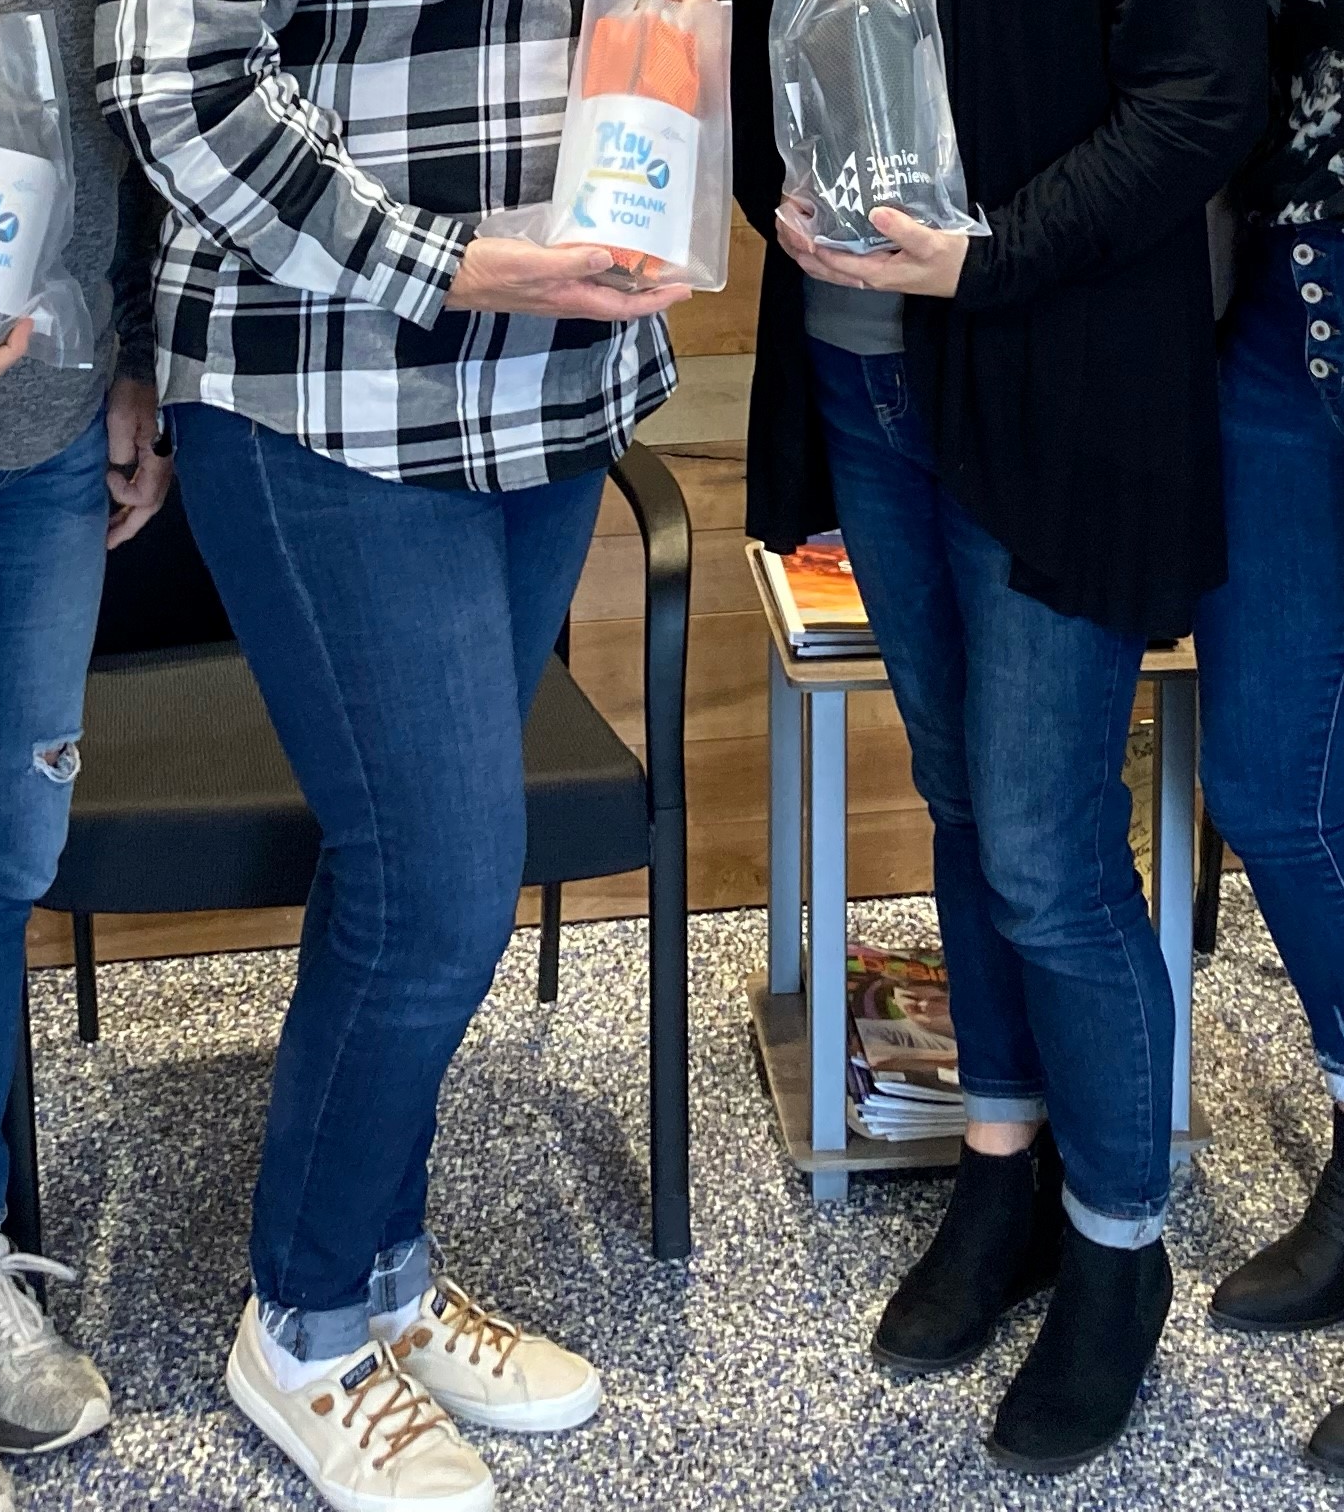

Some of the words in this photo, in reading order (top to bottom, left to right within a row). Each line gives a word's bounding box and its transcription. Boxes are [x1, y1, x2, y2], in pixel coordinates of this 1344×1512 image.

[597, 120, 654, 165] Play
[613, 191, 667, 214] THANK
[610, 209, 651, 229] YOU!
